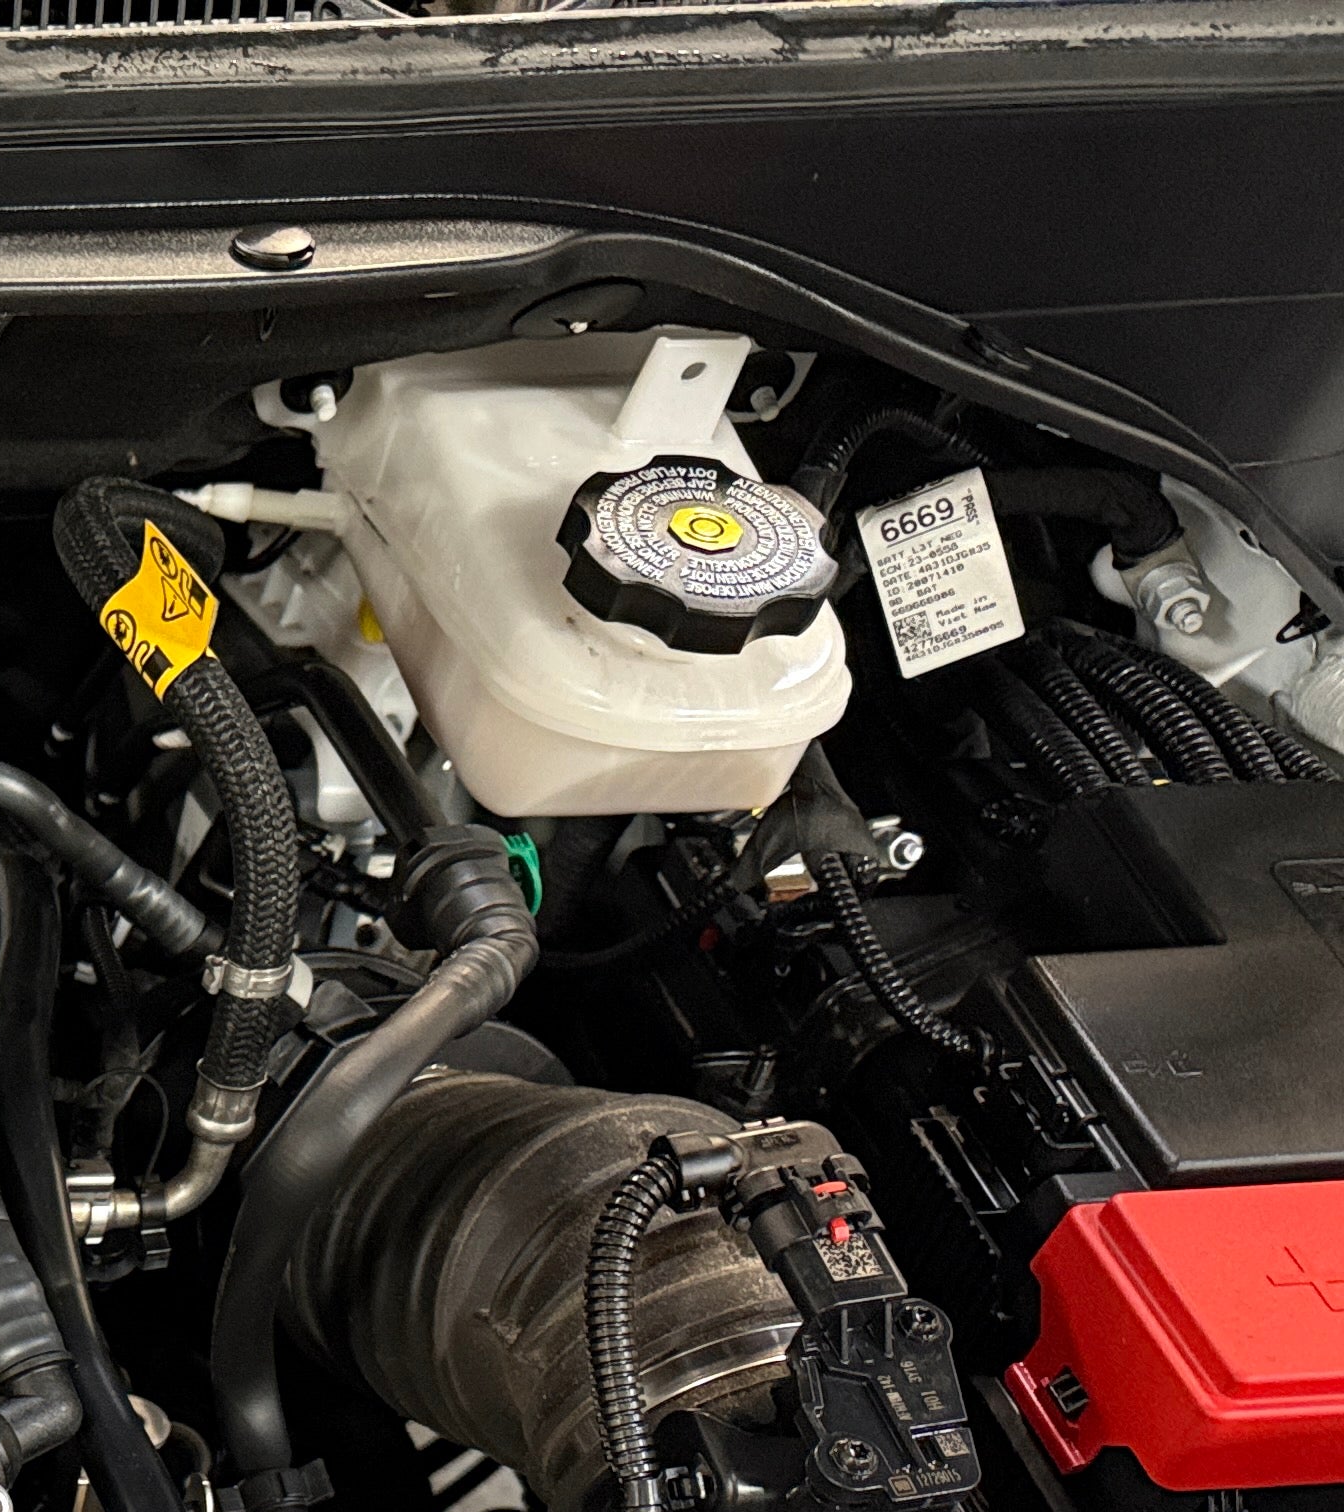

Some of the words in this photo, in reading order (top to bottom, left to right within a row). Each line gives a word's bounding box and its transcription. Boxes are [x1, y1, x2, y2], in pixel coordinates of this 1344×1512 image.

[675, 467, 688, 477] 4
[685, 468, 717, 480] DOT
[684, 479, 716, 490] CAP
[880, 497, 954, 542] 6669
[636, 546, 674, 570] ONLY
[675, 566, 692, 579] 4
[687, 569, 715, 584] DOT
